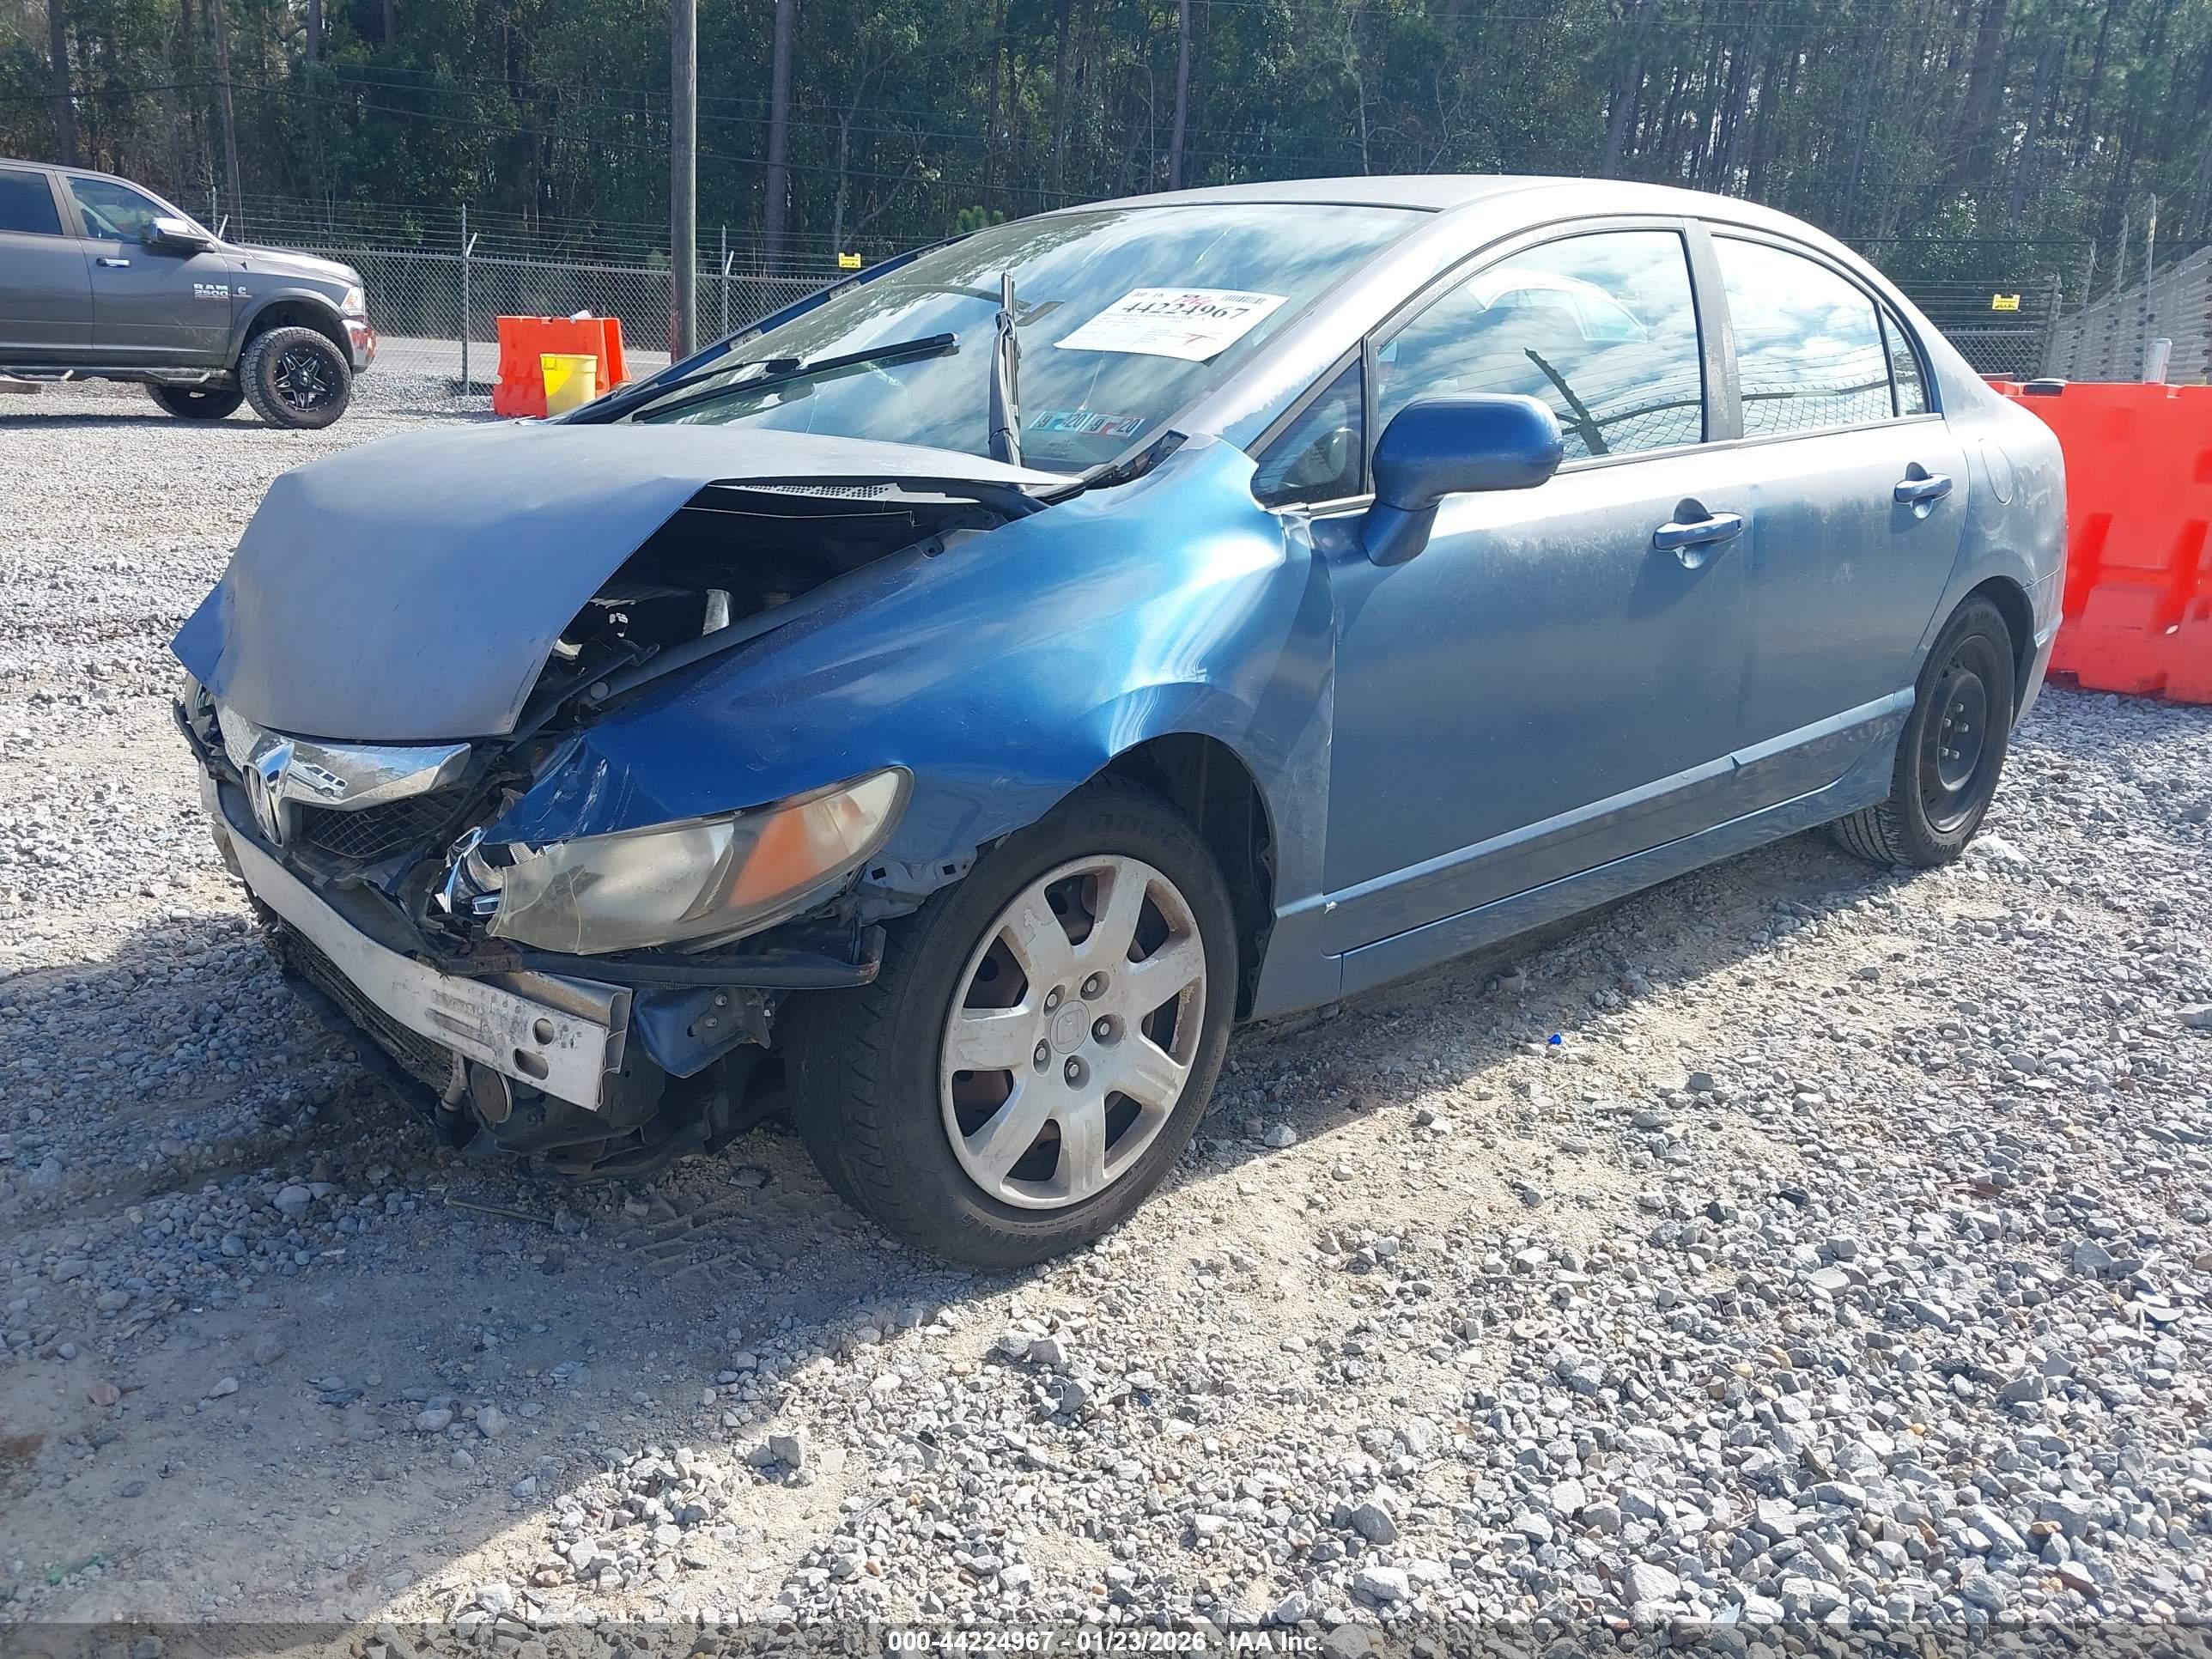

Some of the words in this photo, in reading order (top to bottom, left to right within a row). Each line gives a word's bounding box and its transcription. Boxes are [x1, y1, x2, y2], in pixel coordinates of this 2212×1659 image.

[1122, 301, 1250, 319] 44224967
[1040, 416, 1053, 428] 9
[1091, 418, 1105, 432] 9
